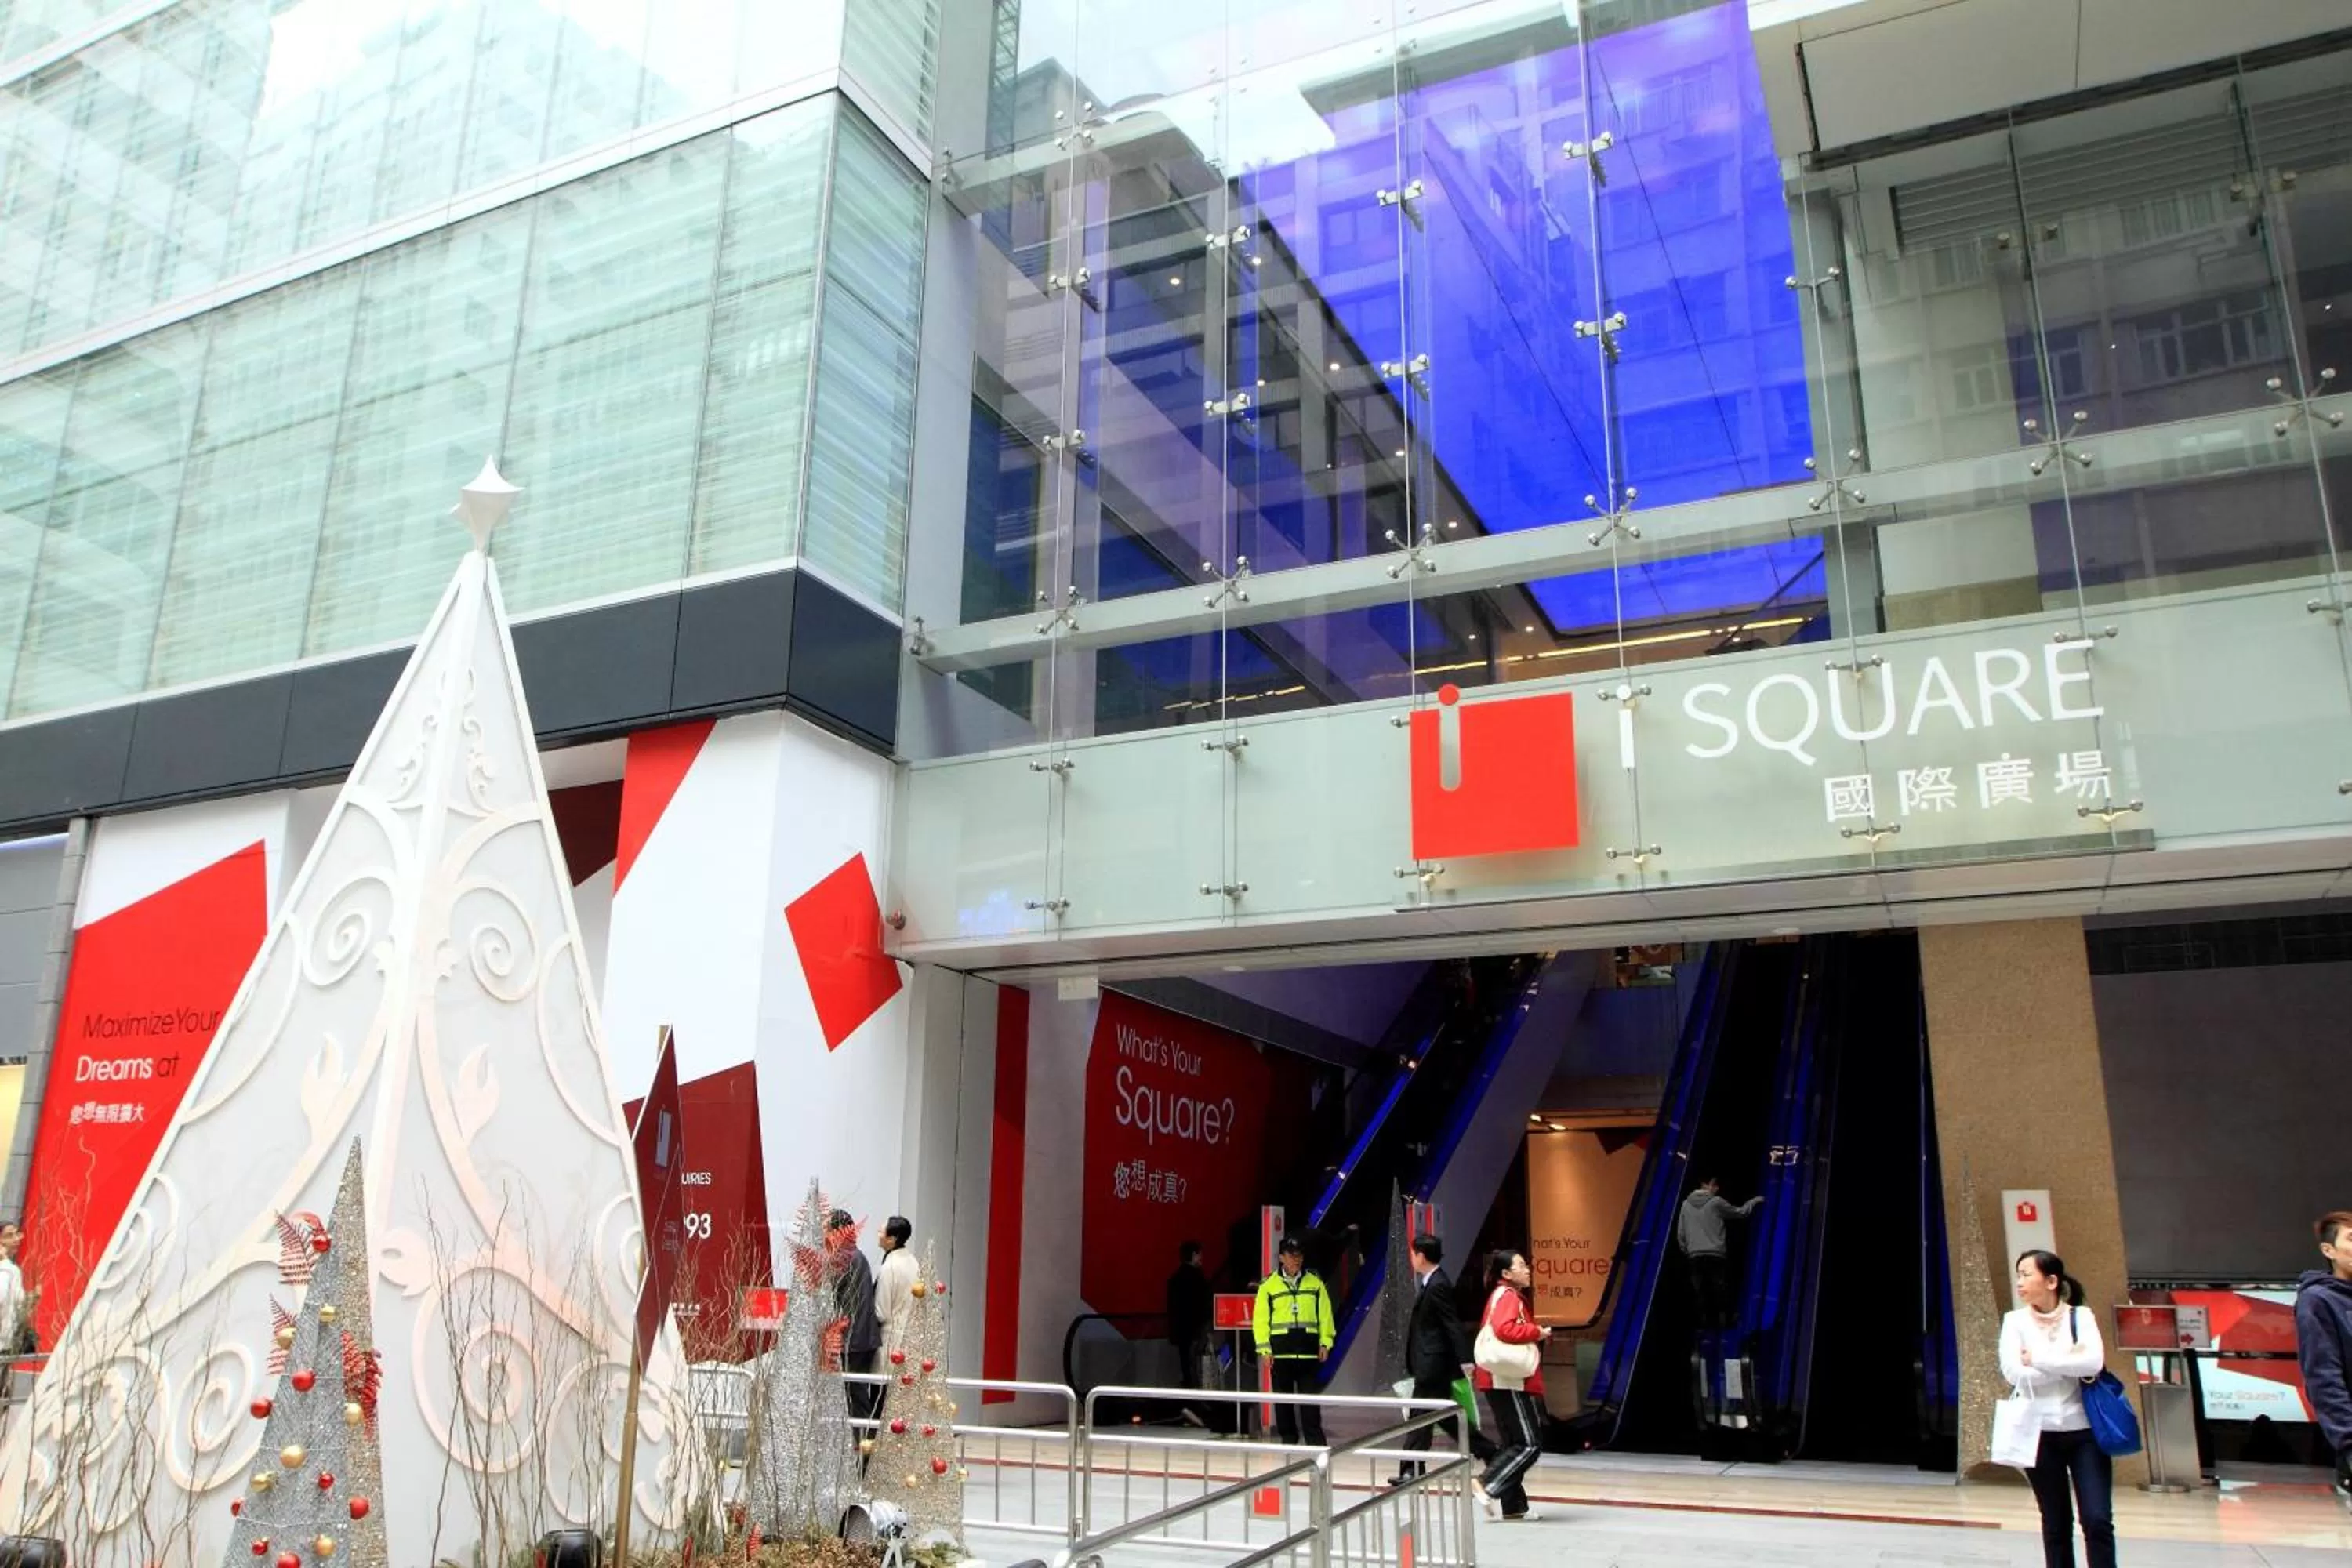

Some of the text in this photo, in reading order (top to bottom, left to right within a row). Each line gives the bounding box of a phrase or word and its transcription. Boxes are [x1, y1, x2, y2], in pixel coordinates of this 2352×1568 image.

[1682, 639, 2105, 767] SQUARE
[1824, 750, 2112, 822] 國際廣場
[75, 1051, 180, 1082] Dreams at
[1116, 1022, 1203, 1076] What's Your
[1116, 1065, 1235, 1145] Square?
[1113, 1157, 1188, 1203] 您想成真?
[684, 1213, 711, 1240] 93
[1532, 1257, 1610, 1279] quare
